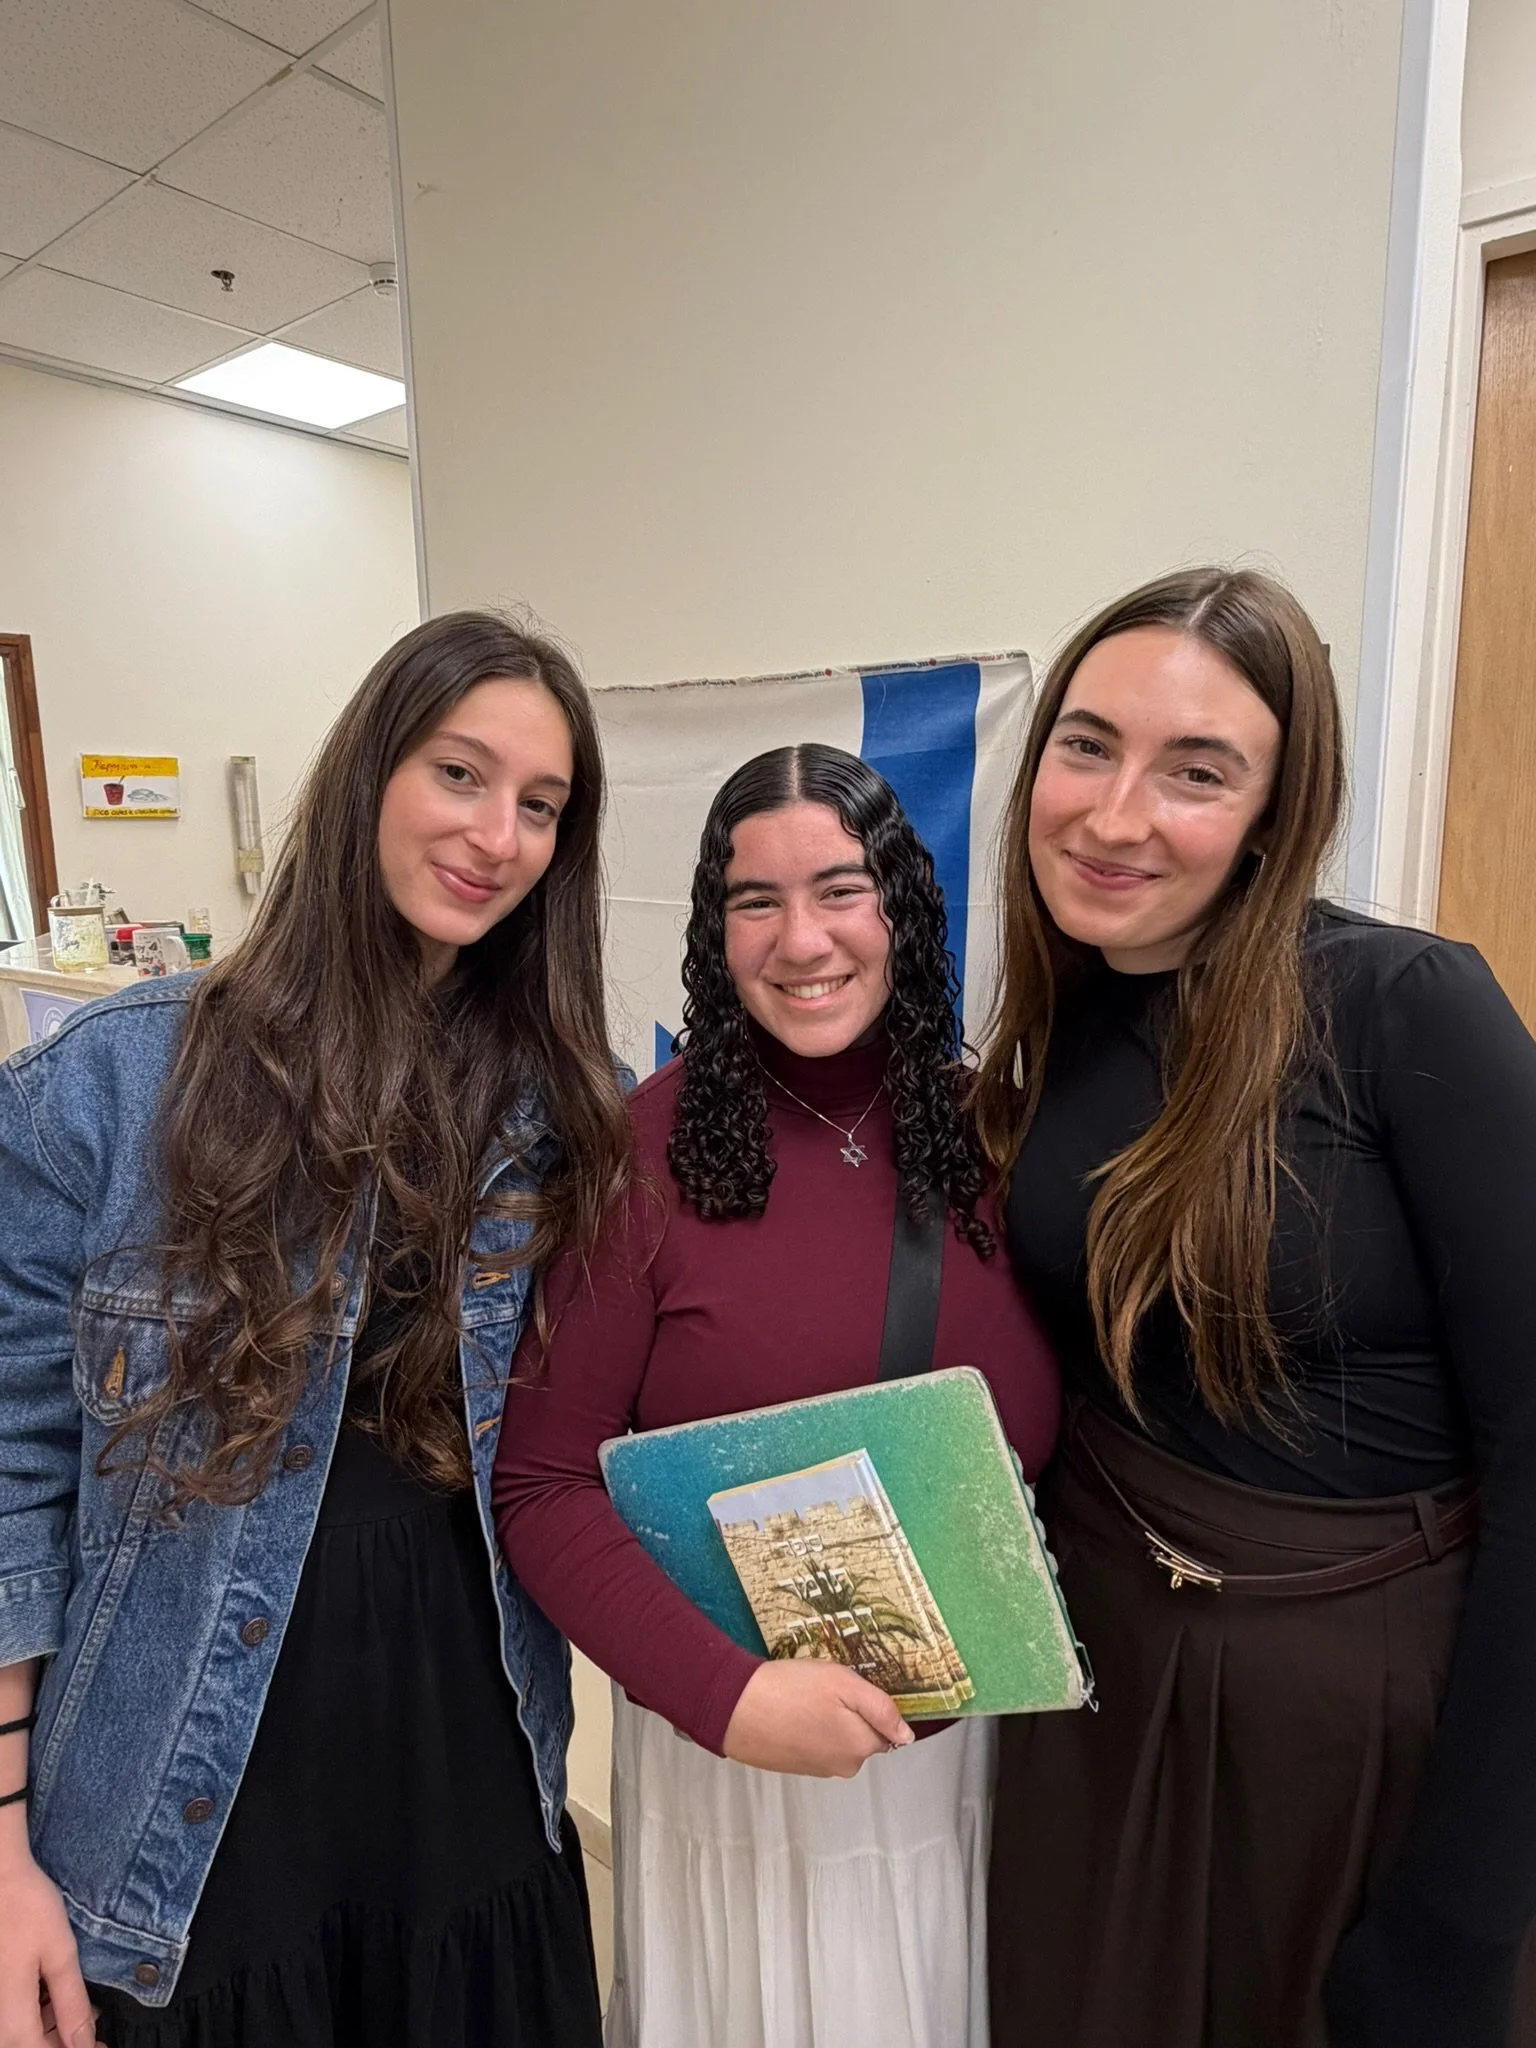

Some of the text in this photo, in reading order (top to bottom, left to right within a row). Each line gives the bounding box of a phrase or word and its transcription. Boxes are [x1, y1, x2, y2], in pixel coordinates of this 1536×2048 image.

[775, 1534, 824, 1558] ספר
[776, 1567, 855, 1601] תומר
[787, 1606, 880, 1644] דבורה
